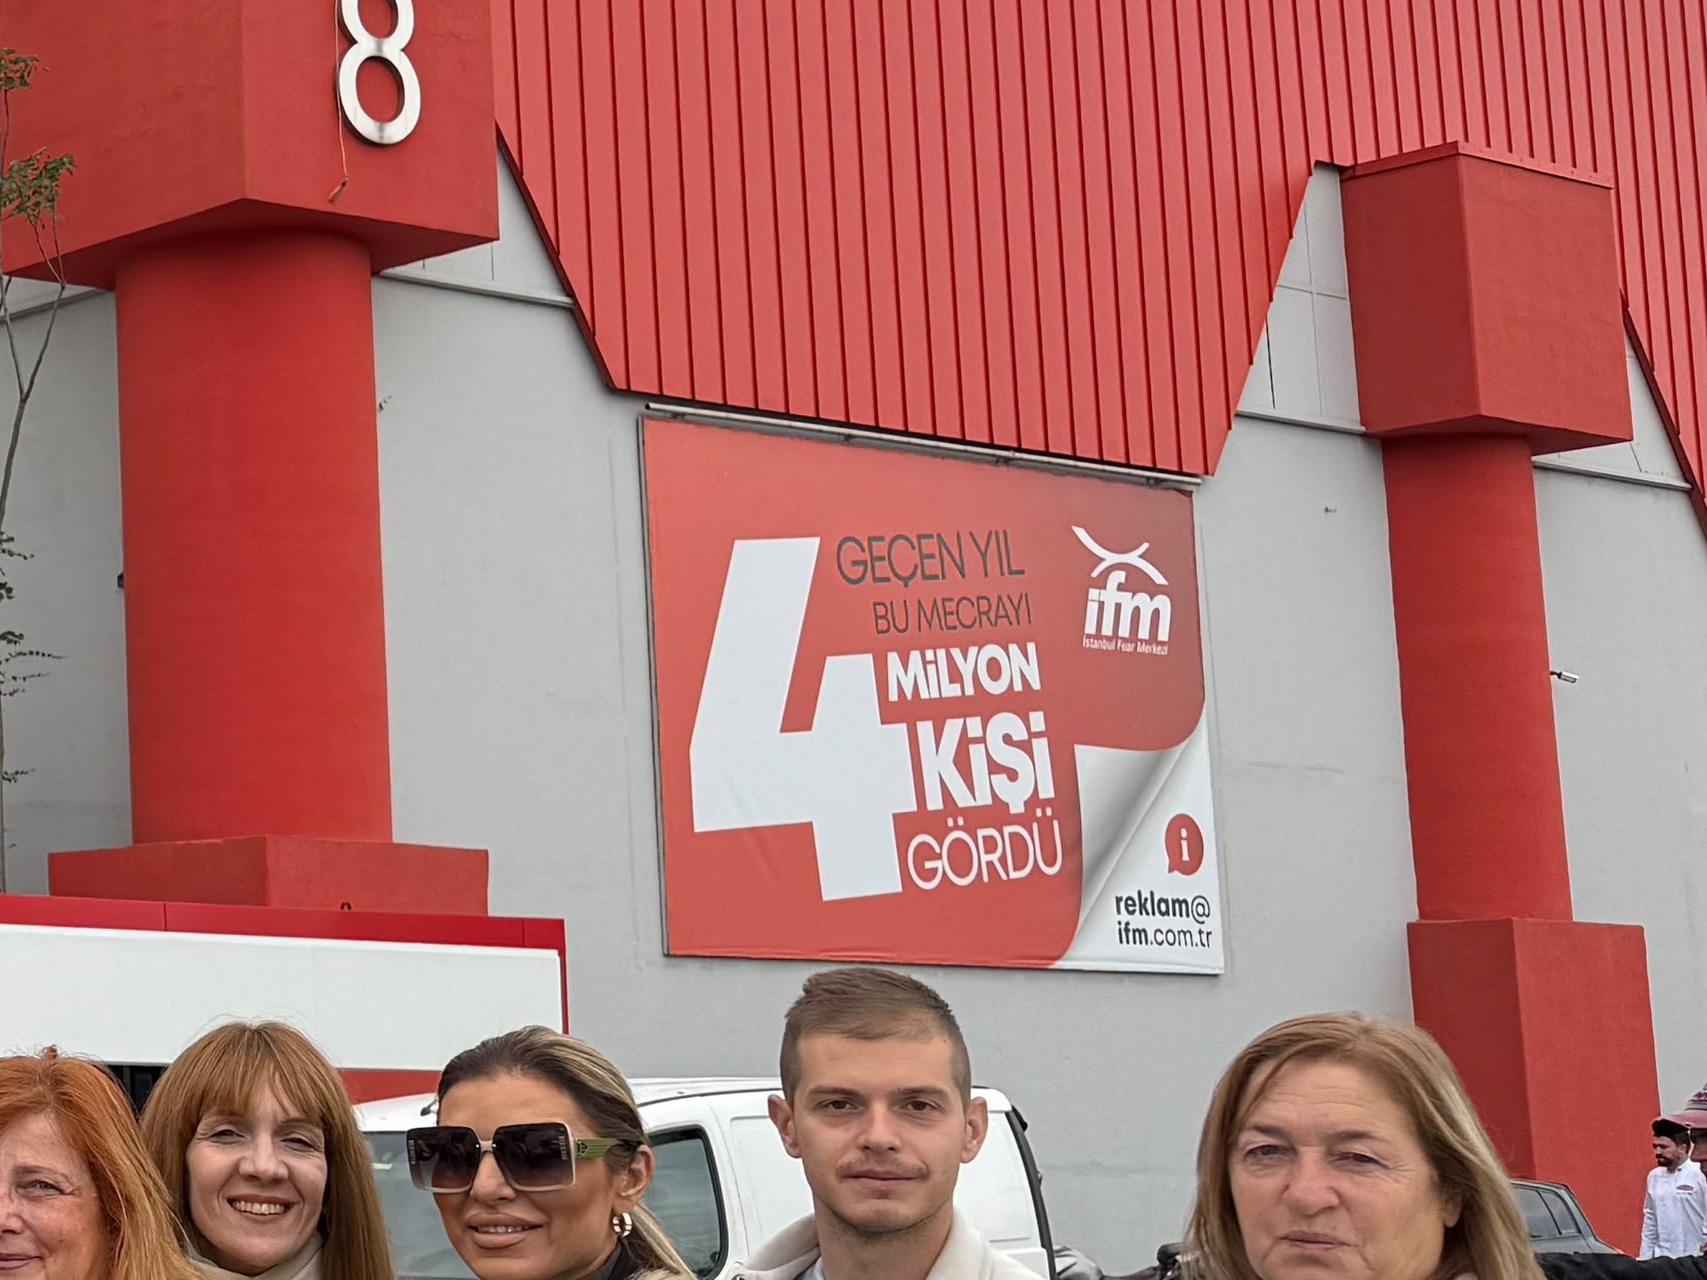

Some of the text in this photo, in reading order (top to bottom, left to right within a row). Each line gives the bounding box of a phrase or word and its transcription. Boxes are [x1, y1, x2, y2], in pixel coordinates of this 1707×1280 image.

[836, 529, 1026, 587] GEÇEN YIL
[873, 592, 1033, 634] BU MECRAYI
[1084, 569, 1172, 642] ifm
[690, 536, 919, 902] 4
[907, 807, 1063, 890] GÖRDÜ
[1115, 889, 1211, 924] reklam@
[1117, 920, 1212, 948] ifm.com.tr
